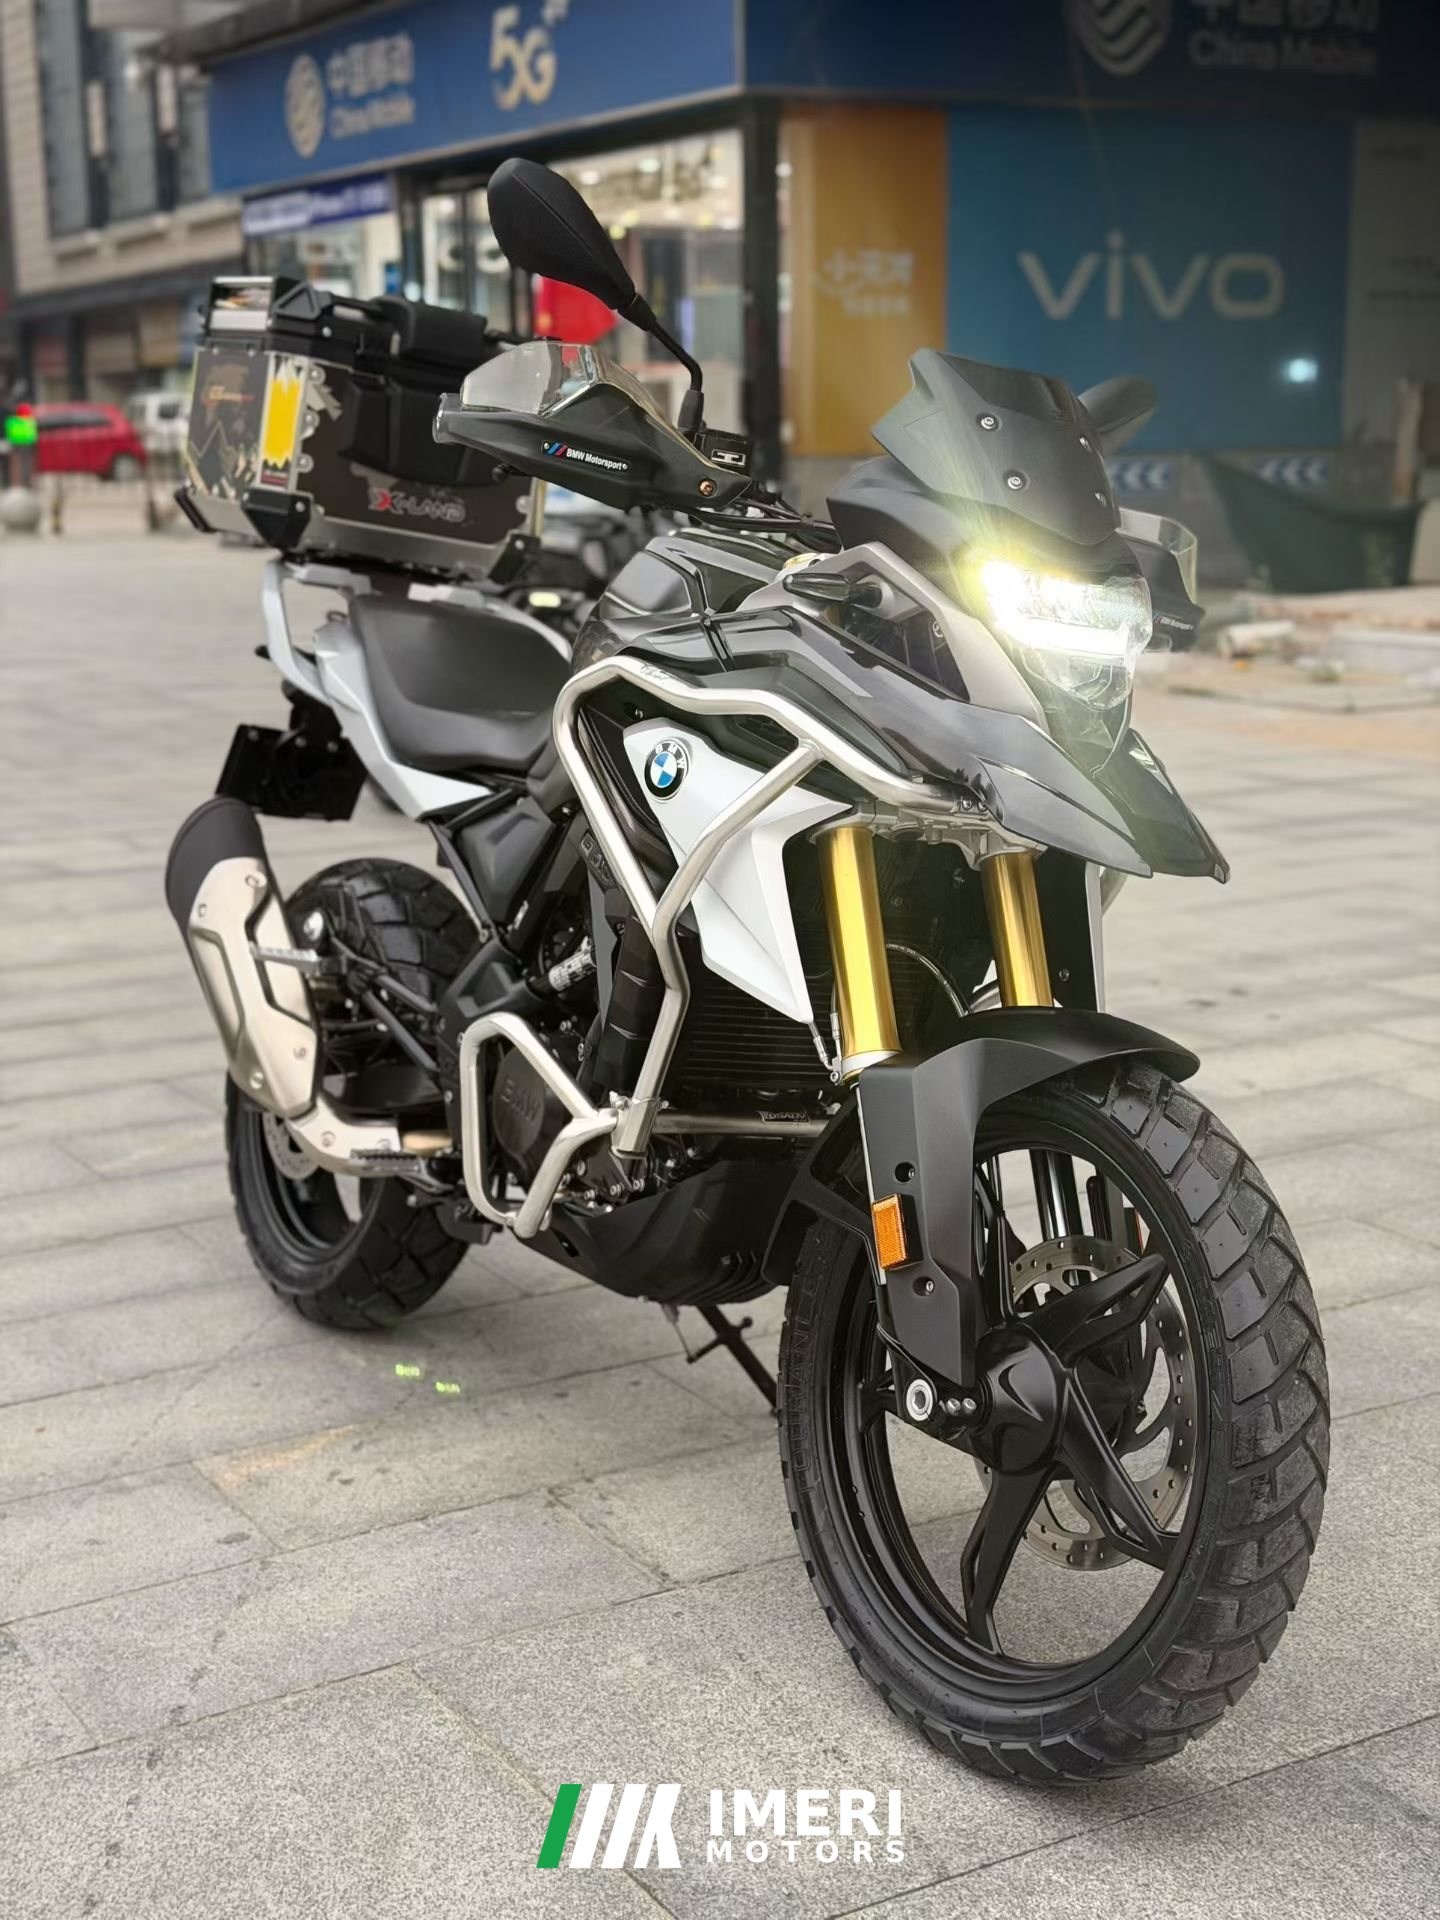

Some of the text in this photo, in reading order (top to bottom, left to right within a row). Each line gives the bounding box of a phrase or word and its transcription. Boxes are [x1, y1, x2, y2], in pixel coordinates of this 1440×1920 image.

[491, 5, 557, 110] 5G
[1018, 229, 1284, 321] vivo
[566, 448, 622, 470] BMW Motorsport
[655, 742, 685, 769] BMW
